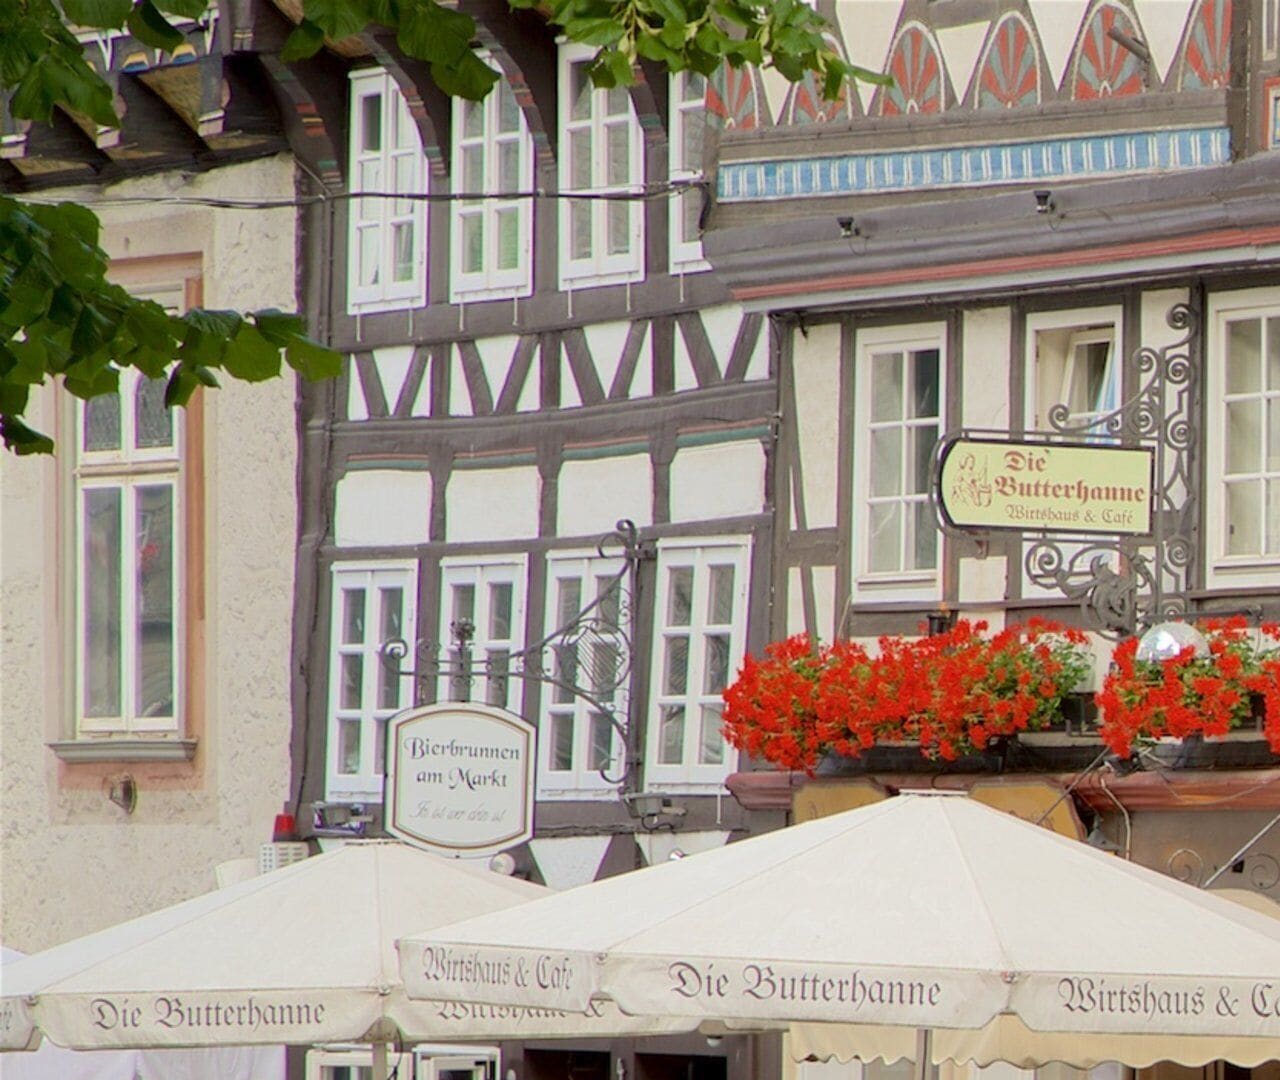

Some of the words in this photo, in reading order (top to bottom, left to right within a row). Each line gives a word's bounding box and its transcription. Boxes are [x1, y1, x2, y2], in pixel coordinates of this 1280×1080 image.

[1004, 450, 1048, 473] Die
[994, 475, 1145, 506] Butterhanne
[1005, 503, 1080, 522] Wirtshaus
[1083, 511, 1098, 524] &
[403, 736, 521, 761] Bierbrunnen
[416, 770, 443, 785] am
[447, 766, 508, 791] Markt
[422, 946, 511, 988] Wirtshaus
[515, 956, 530, 986] &
[667, 960, 729, 999] Die
[741, 963, 942, 1007] Butterhanne
[1057, 976, 1206, 1022] Wirtshaus
[1214, 984, 1240, 1018] &
[92, 998, 142, 1031] Die
[153, 995, 326, 1032] Butterhanne
